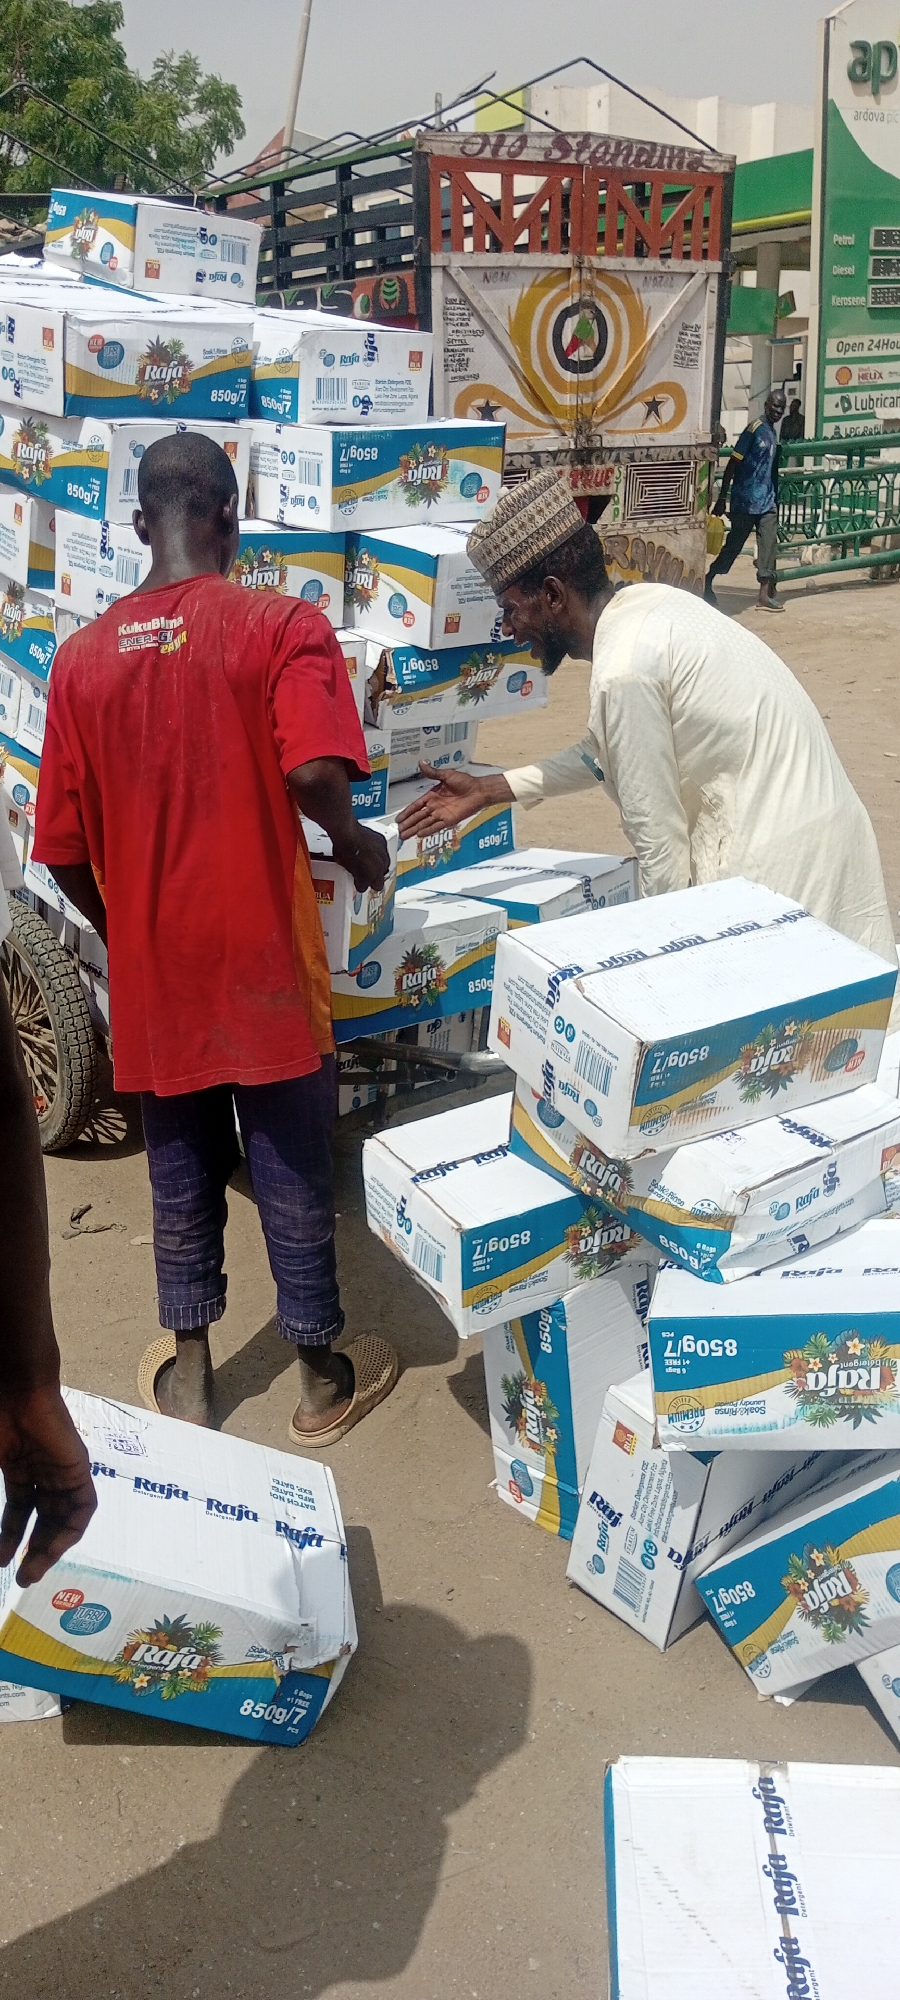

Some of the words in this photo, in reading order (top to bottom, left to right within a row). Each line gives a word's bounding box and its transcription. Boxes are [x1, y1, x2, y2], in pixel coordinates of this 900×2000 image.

[854, 109, 885, 122] ardova
[833, 233, 855, 246] Petrol
[832, 264, 855, 275] Diesel
[831, 294, 866, 307] Kerosene
[836, 340, 865, 356] Open
[339, 353, 361, 367] Raja
[144, 361, 184, 384] Raja
[857, 370, 884, 381] HELIX
[210, 389, 247, 405] 850g/7
[261, 395, 292, 416] 850g/7
[17, 443, 46, 464] Raja
[340, 445, 378, 462] 850g/7
[407, 463, 443, 485] Raja
[67, 483, 100, 505] 850g/7
[240, 568, 281, 590] Raja
[4, 602, 22, 622] Raja
[118, 616, 184, 637] KukuBima
[28, 643, 52, 664] 850g/7
[401, 658, 440, 675] 850g/7
[465, 668, 498, 689] Raja
[351, 790, 381, 807] 50g/7
[421, 828, 453, 851] Raja
[478, 828, 509, 850] 850g/7
[716, 921, 763, 939] Raja
[658, 934, 708, 955] Raja
[597, 950, 650, 970] Raja
[401, 965, 438, 990] Raja
[546, 966, 585, 1010] Raja
[651, 1045, 710, 1073] 850g/7
[748, 1046, 795, 1077] Raja
[558, 1079, 580, 1104] Raja
[639, 1112, 672, 1133] PREMIUM
[411, 1161, 459, 1184] Raja
[577, 1149, 623, 1194] Raja
[795, 1187, 820, 1211] Raja
[472, 1230, 532, 1261] 850g/7
[578, 1226, 632, 1255] Raja
[782, 1267, 844, 1277] Raja
[663, 1334, 738, 1358] 850g/7
[840, 1359, 882, 1369] Detergent
[805, 1365, 882, 1398] Raja
[742, 1399, 766, 1407] Laundry
[521, 1389, 541, 1445] Raja
[667, 1407, 706, 1426] PREMIUM
[622, 1432, 634, 1454] BUA
[132, 1488, 165, 1500] Detergent
[133, 1476, 190, 1502] Raja
[271, 1485, 295, 1498] DATE:
[272, 1477, 295, 1491] DATE:
[296, 1485, 313, 1496] EXP.
[287, 1497, 317, 1511] BATCH
[295, 1493, 315, 1504] MFD.
[205, 1510, 236, 1522] Detergent
[206, 1497, 260, 1523] Raja
[275, 1519, 325, 1550] Raja
[57, 1590, 81, 1604] NEW
[712, 1580, 756, 1614] 850g/7
[803, 1571, 854, 1614] Raja
[73, 1606, 108, 1622] TURBO
[67, 1618, 100, 1634] CLEAN
[131, 1643, 205, 1671] Raja
[294, 1698, 310, 1709] FREE
[299, 1690, 313, 1700] Bags
[239, 1698, 308, 1725] 850g/7
[286, 1726, 300, 1735] PCS
[752, 1777, 788, 1836] Raja
[783, 1805, 796, 1837] Detergent
[762, 1854, 800, 1918] Raja
[795, 1883, 808, 1918] Detergent
[774, 1936, 812, 2000] Raja
[808, 1969, 821, 2000] tergent
